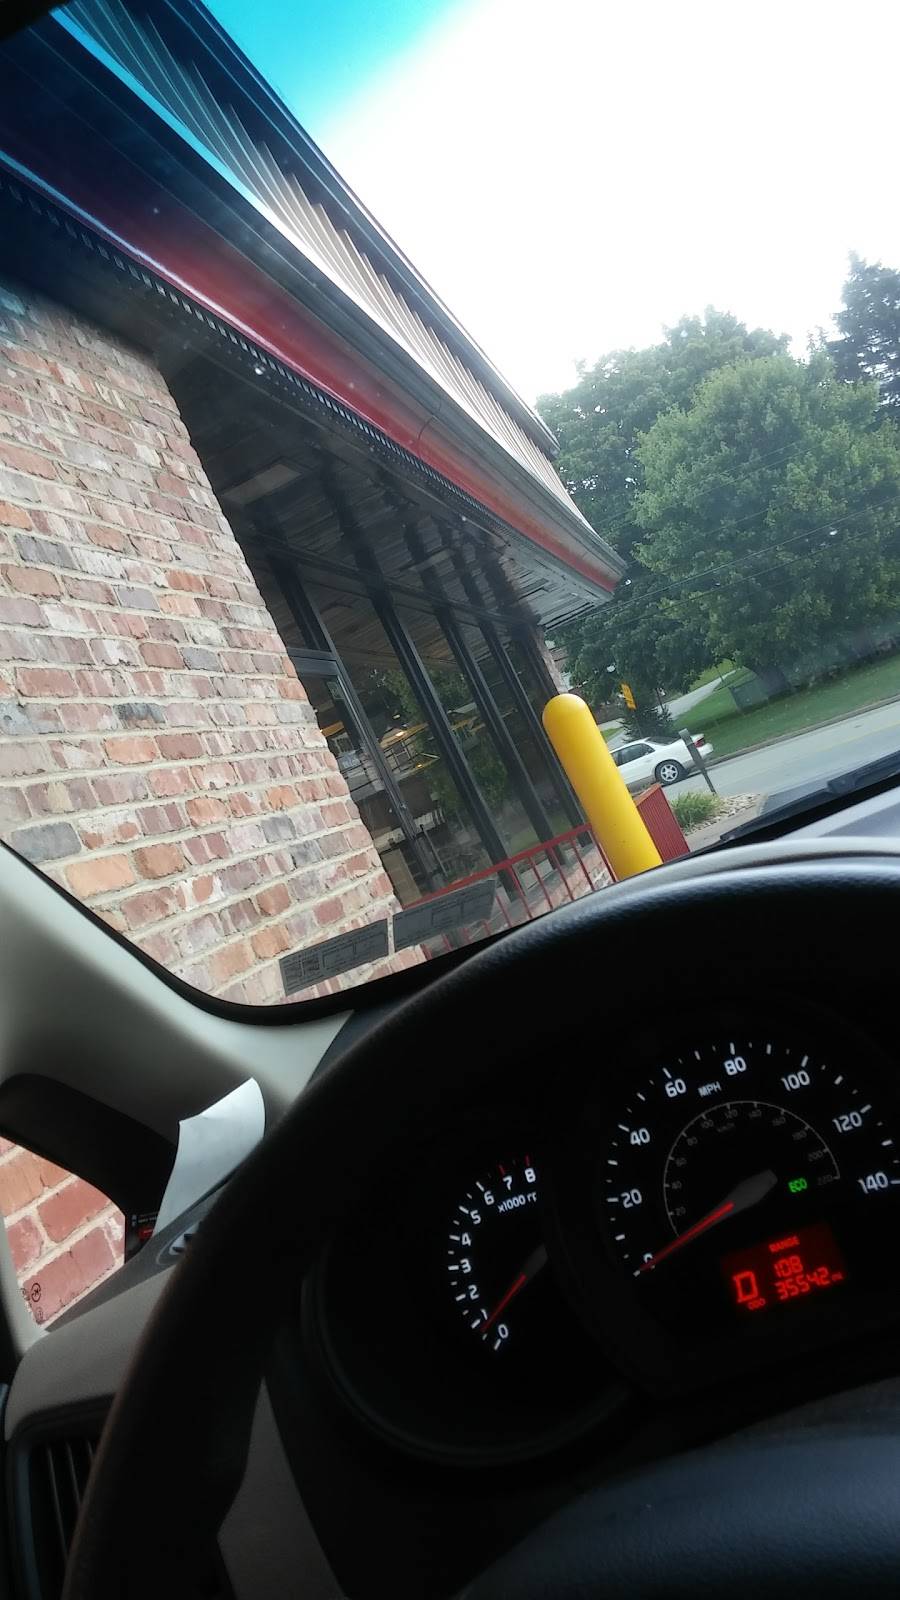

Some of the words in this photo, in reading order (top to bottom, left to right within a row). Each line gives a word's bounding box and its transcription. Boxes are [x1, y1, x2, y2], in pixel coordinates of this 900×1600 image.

[724, 1056, 747, 1076] 80
[665, 1078, 687, 1098] 60
[698, 1082, 721, 1097] MPH
[781, 1070, 811, 1092] 100
[833, 1111, 863, 1133] 120
[630, 1128, 651, 1146] 40
[503, 1175, 513, 1190] 7
[524, 1167, 536, 1183] 8
[858, 1171, 889, 1194] 140
[484, 1190, 495, 1206] 6
[498, 1194, 526, 1213] x1000
[621, 1189, 643, 1208] 20
[470, 1209, 481, 1225] 5
[461, 1232, 472, 1247] 4
[460, 1258, 471, 1273] 3
[774, 1255, 804, 1277] 108
[468, 1284, 480, 1300] 2
[774, 1267, 830, 1300] 35542
[498, 1324, 509, 1338] 0
